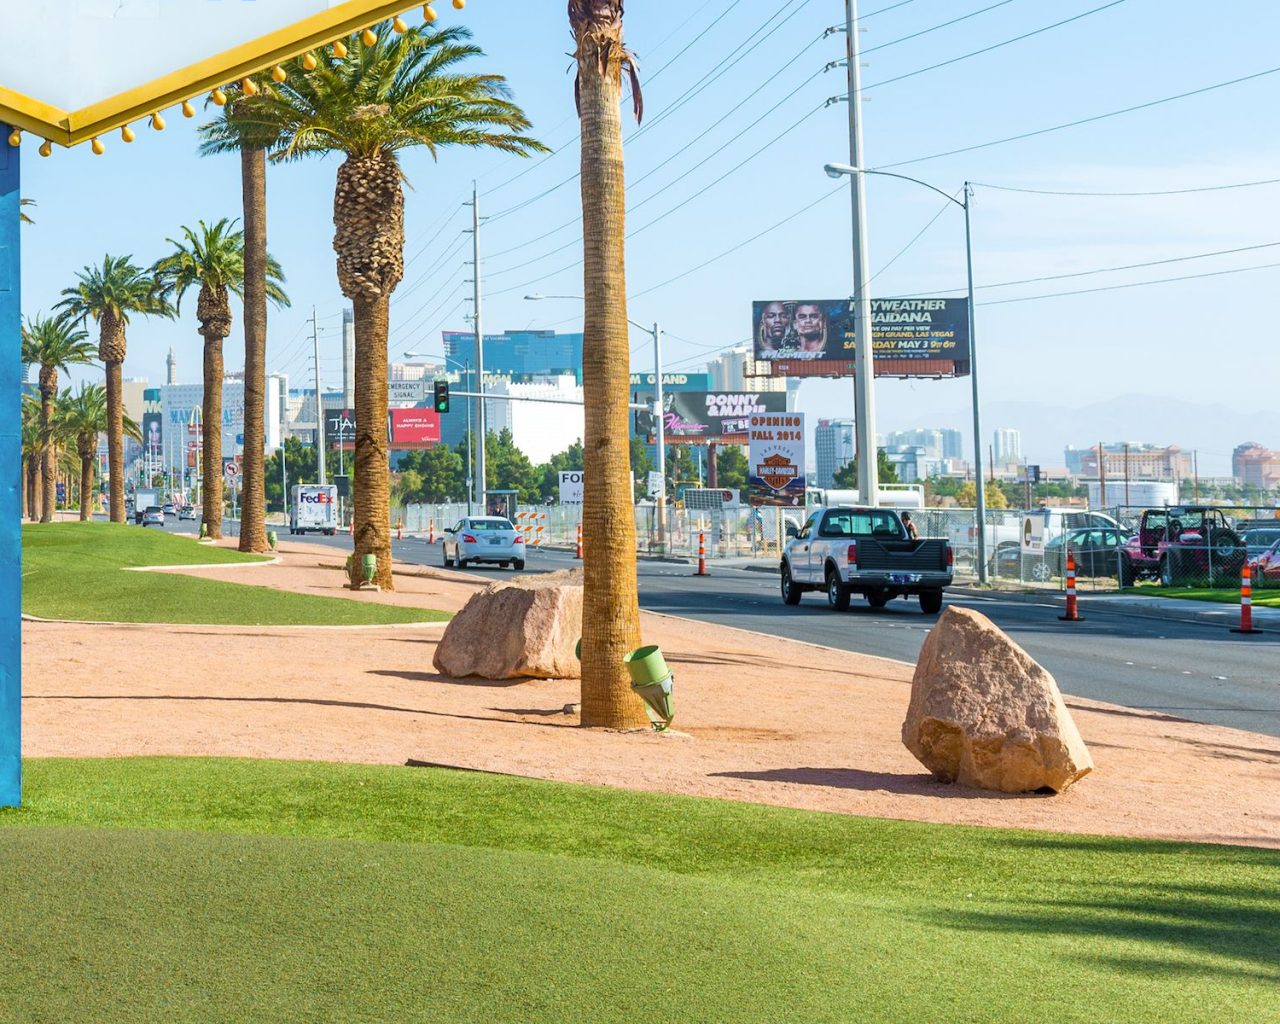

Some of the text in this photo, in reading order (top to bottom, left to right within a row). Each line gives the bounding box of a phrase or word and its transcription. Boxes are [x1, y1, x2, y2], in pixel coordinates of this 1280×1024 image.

[871, 312, 932, 323] AIDANA
[930, 330, 954, 338] VEGAS
[897, 340, 922, 349] MAY
[922, 340, 929, 348] 3
[646, 374, 688, 385] GAND
[705, 394, 760, 406] DONNY
[751, 416, 801, 426] OPENING
[751, 430, 802, 441] FALL 2014
[562, 473, 584, 483] FO
[300, 492, 334, 503] FedEx
